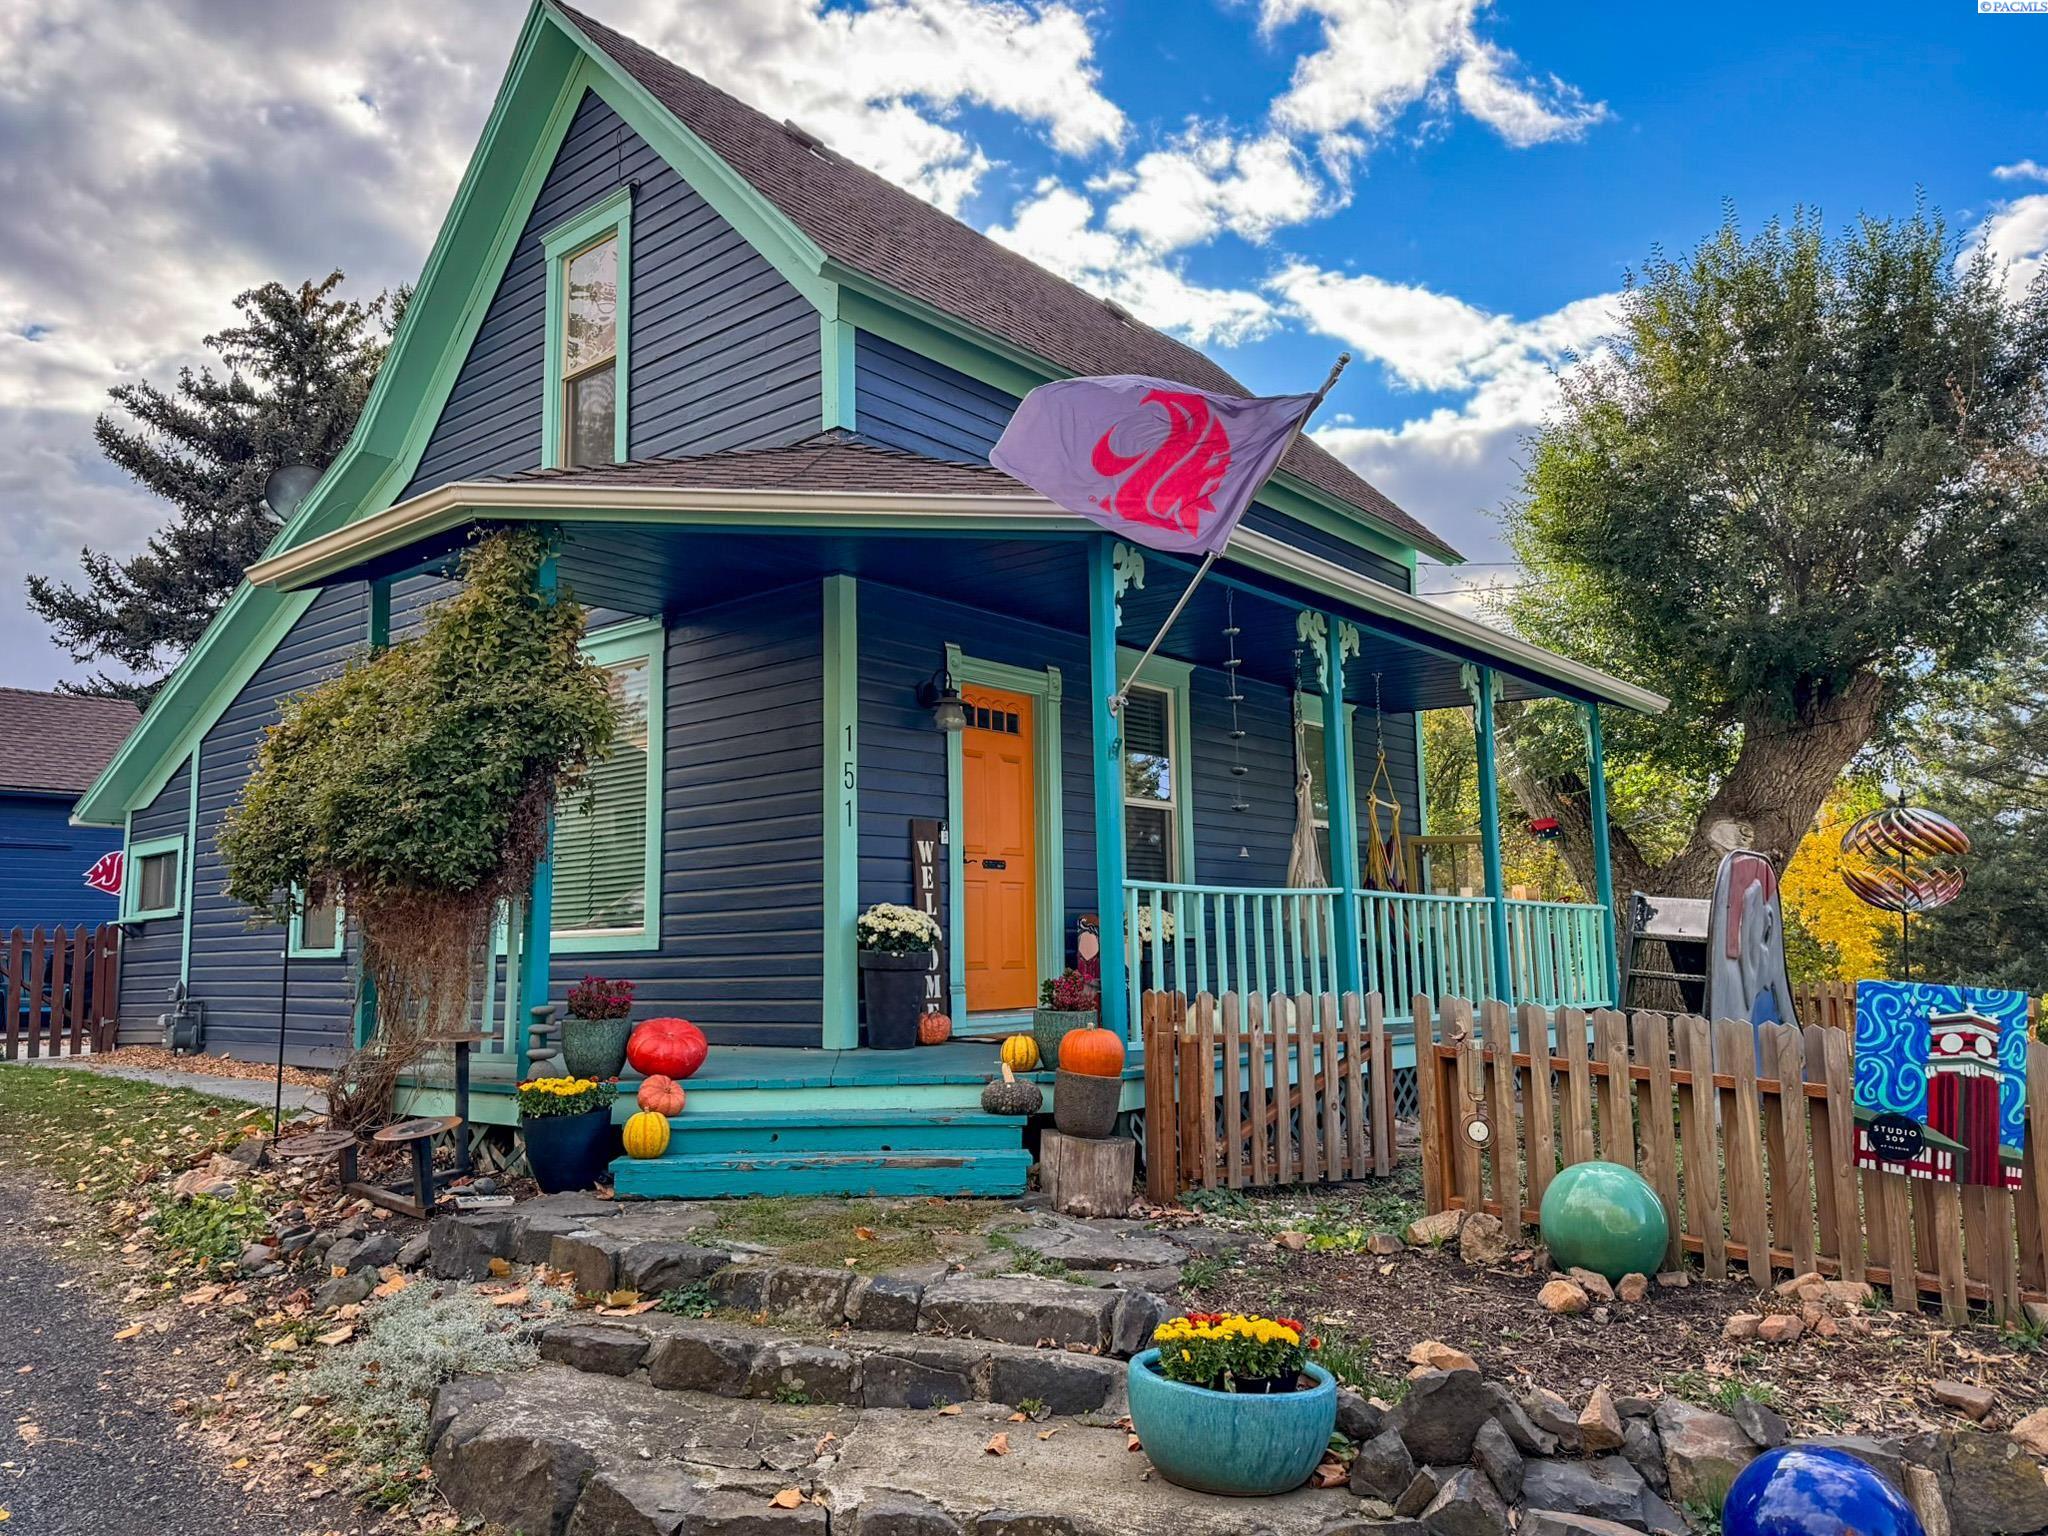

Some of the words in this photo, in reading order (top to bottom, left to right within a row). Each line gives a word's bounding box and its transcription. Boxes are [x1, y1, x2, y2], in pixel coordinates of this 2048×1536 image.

[844, 724, 855, 828] 151
[916, 840, 942, 1014] WELOM
[1873, 1125, 1917, 1137] STUDIO
[1885, 1135, 1905, 1143] 509
